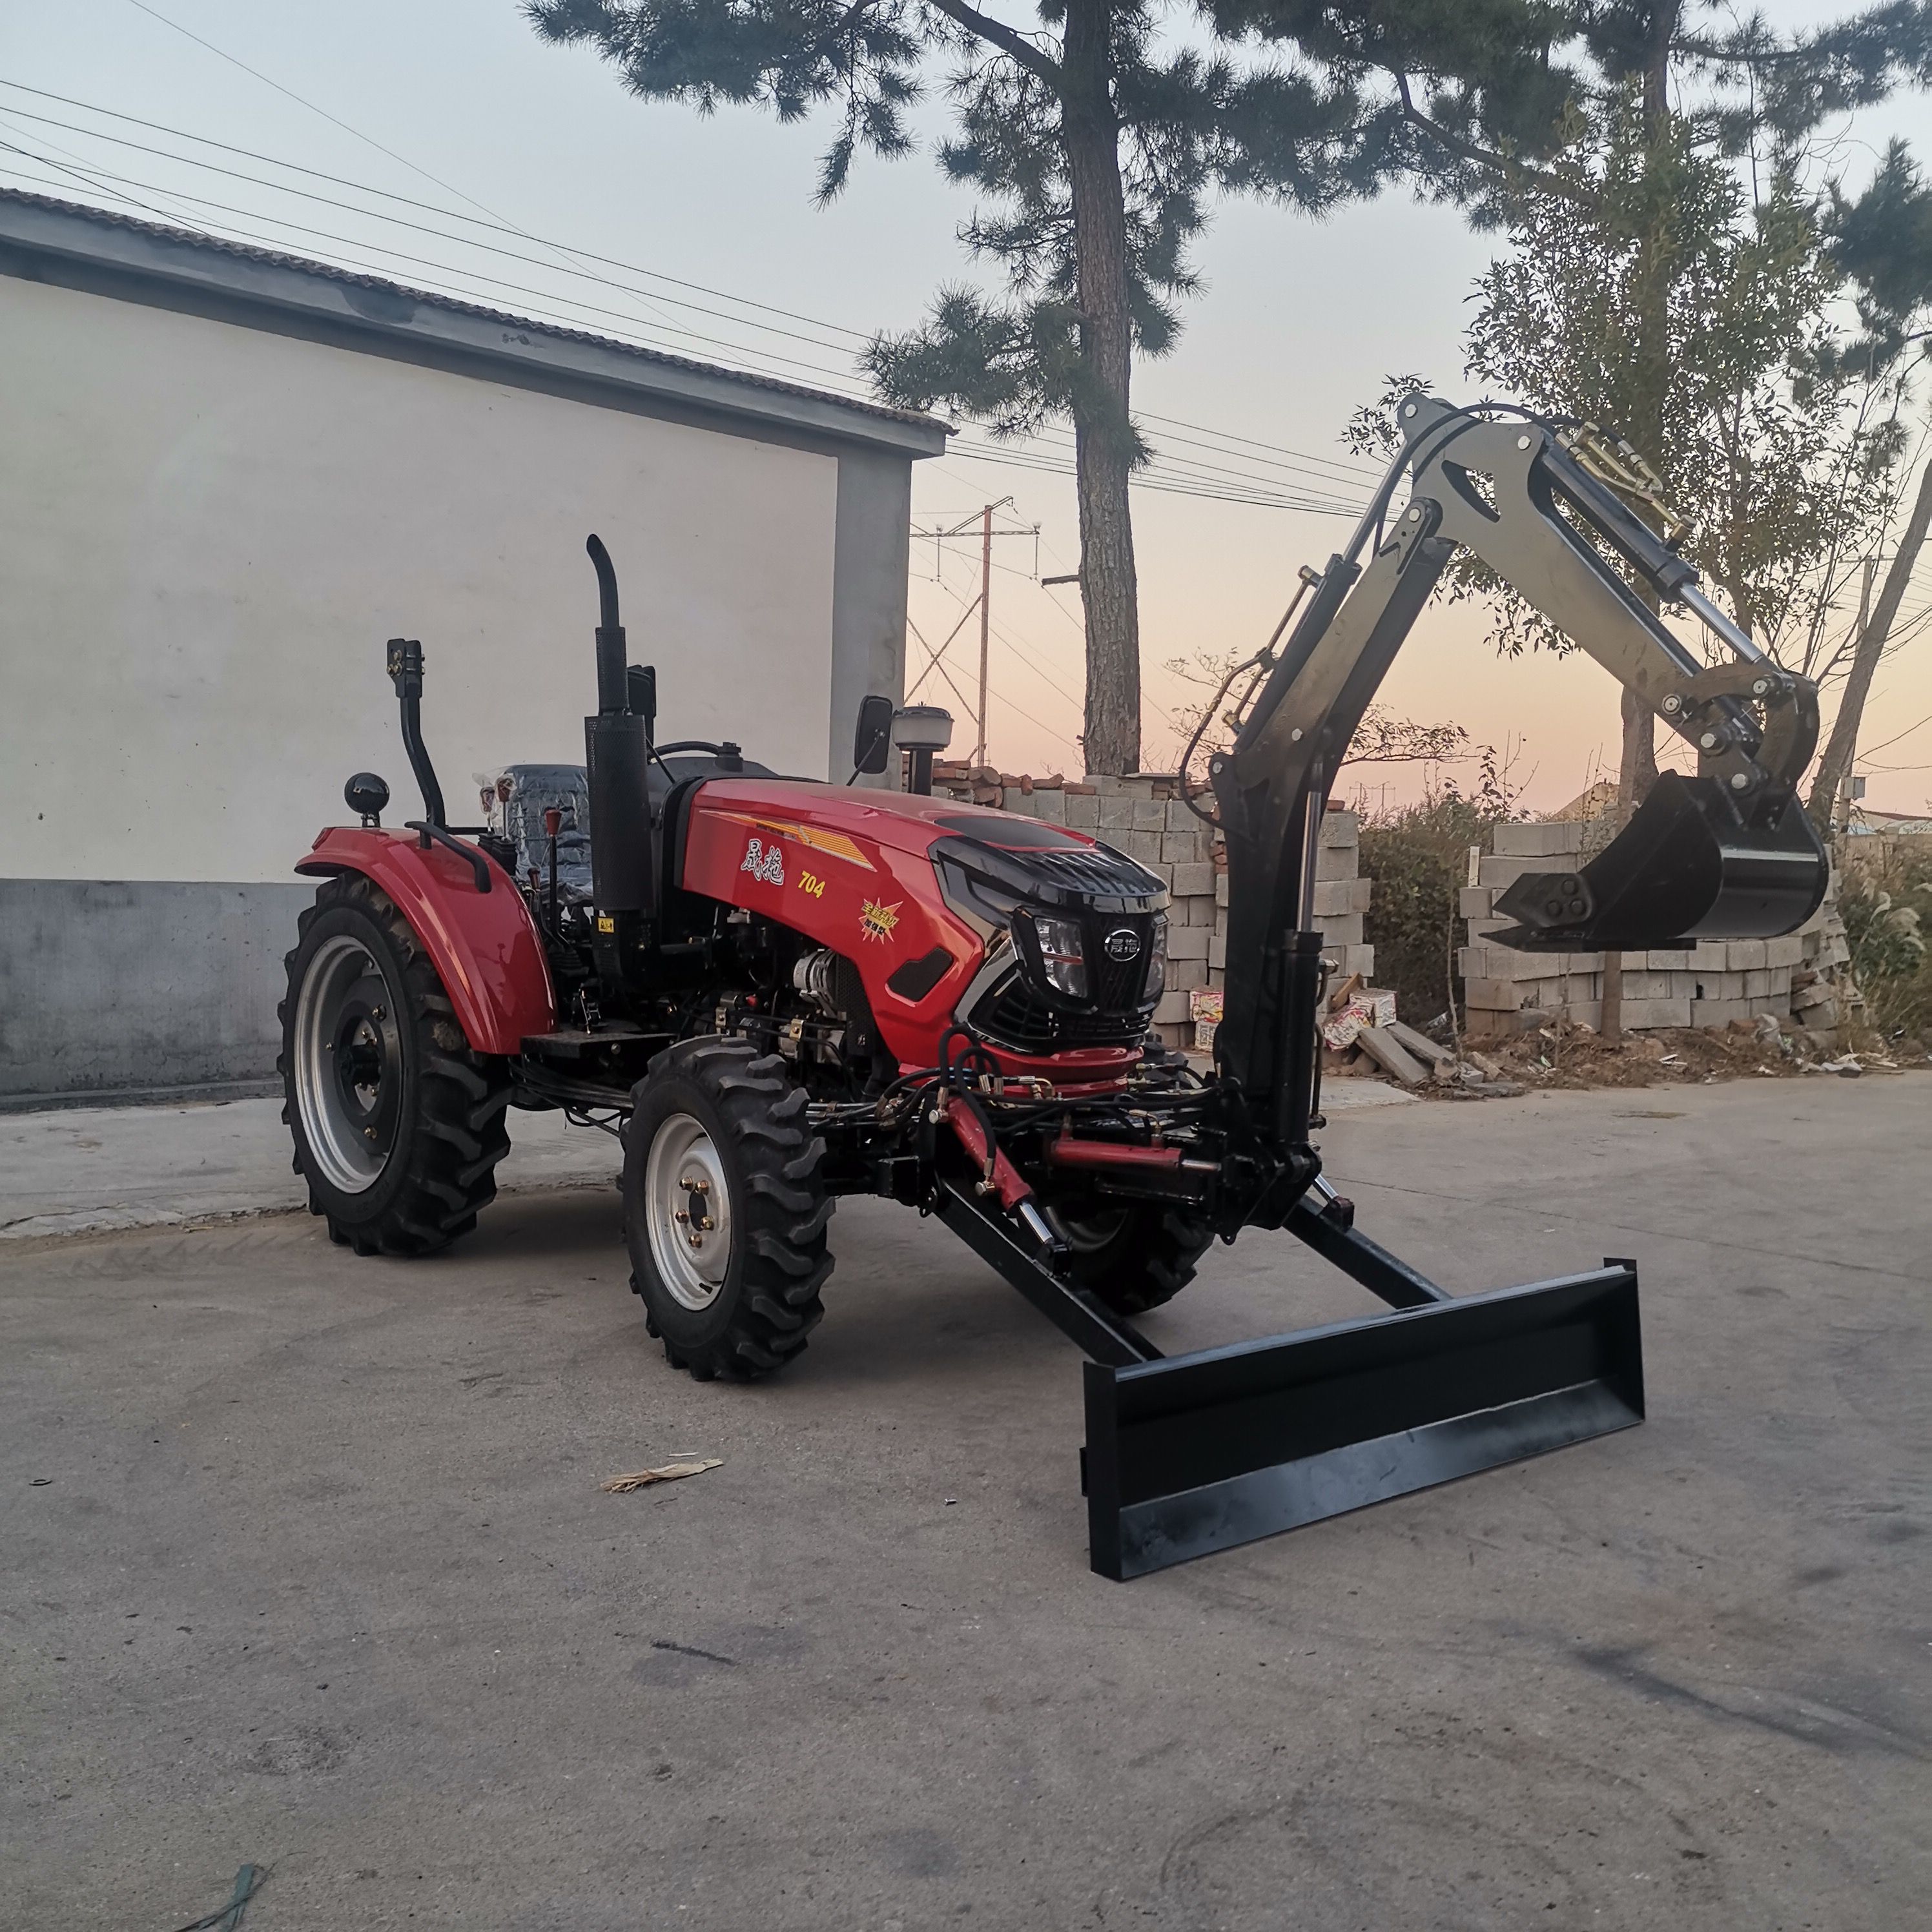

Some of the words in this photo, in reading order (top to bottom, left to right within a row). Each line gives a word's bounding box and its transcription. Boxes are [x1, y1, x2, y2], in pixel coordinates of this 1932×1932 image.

[741, 839, 784, 885] 晟拖
[798, 870, 826, 898] 704
[862, 901, 898, 927] 全新升级
